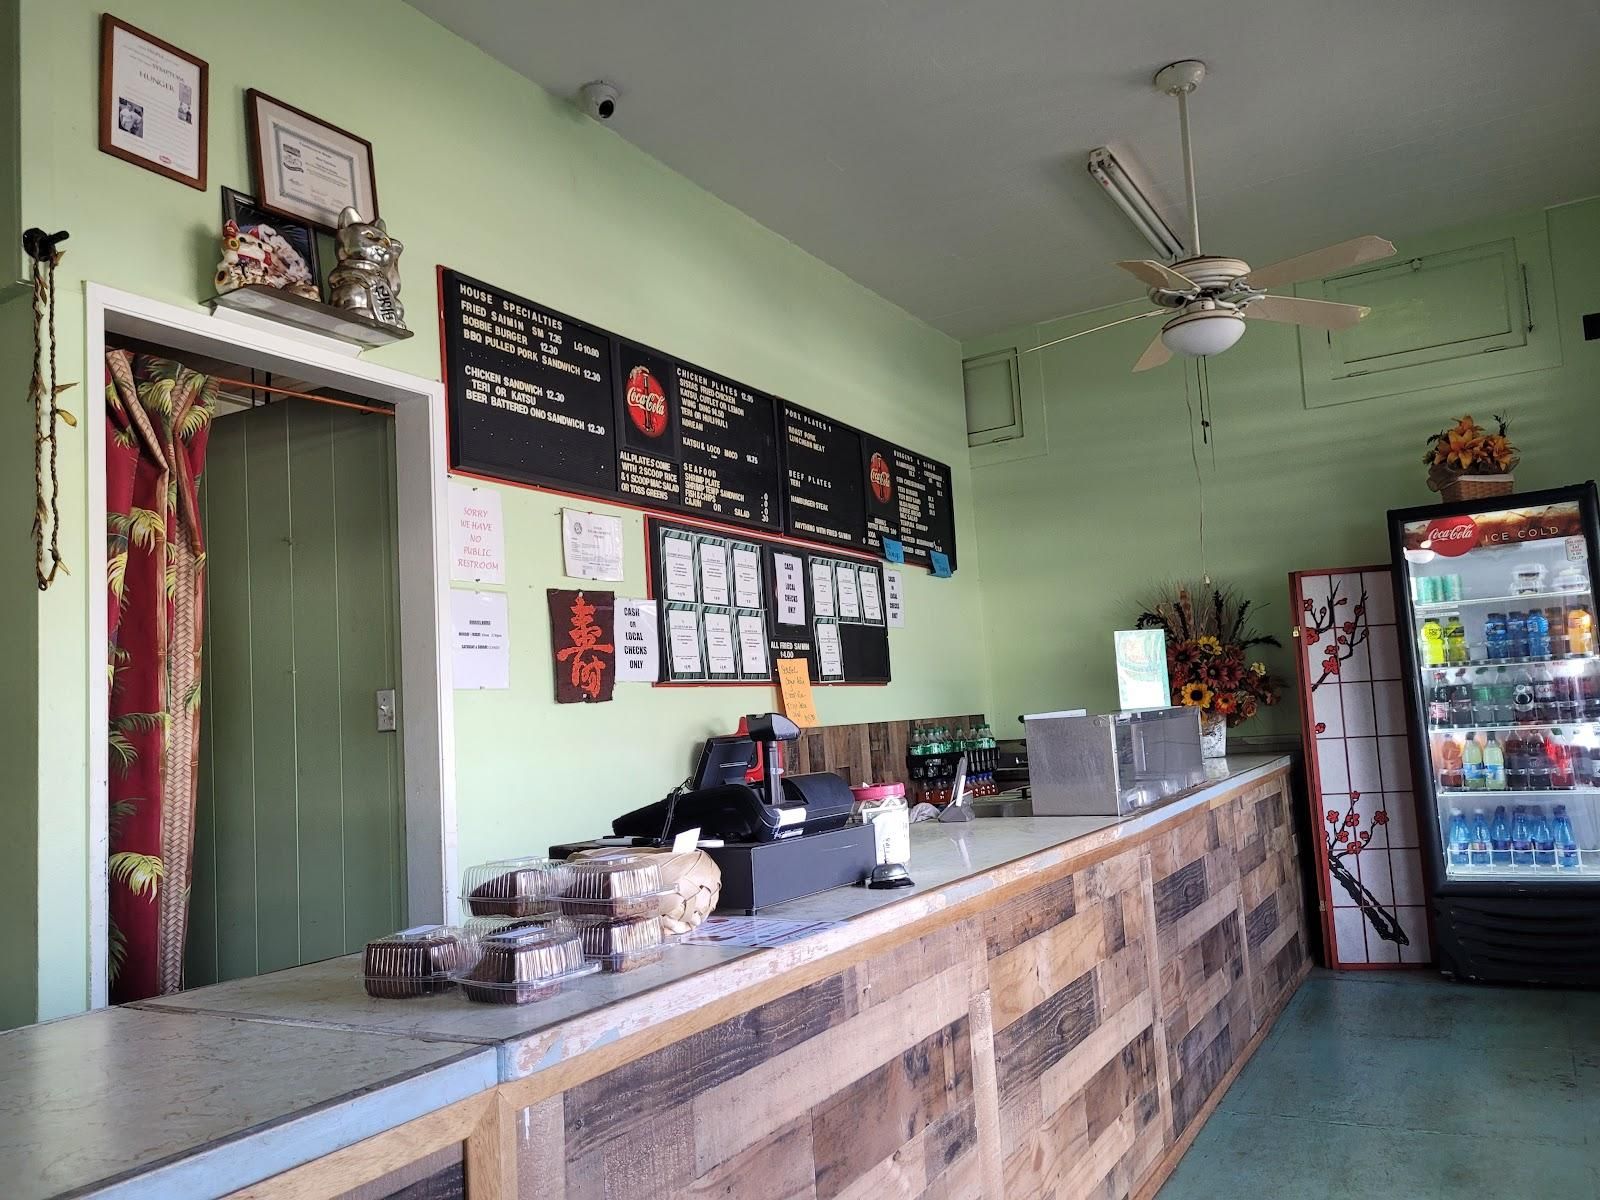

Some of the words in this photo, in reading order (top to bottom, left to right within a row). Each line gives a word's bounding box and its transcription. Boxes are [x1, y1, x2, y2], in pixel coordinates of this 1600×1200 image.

[460, 284, 492, 304] HOUSE
[503, 301, 562, 330] SPECIALTIES
[461, 300, 486, 317] FRIED
[491, 312, 524, 331] SAIMIN
[532, 326, 544, 338] SM
[574, 341, 583, 352] LG
[463, 315, 492, 333] BOBBIE
[495, 325, 528, 345] BURGER
[540, 343, 558, 355] 12.30
[464, 329, 482, 343] BBQ
[485, 336, 515, 354] PULLED
[517, 347, 538, 362] PORK
[542, 355, 580, 375] SANDWICH
[583, 369, 601, 382] 12.30
[465, 365, 501, 384] CHICKEN
[503, 376, 542, 396] SANDWICH
[546, 390, 564, 402] 12.30
[677, 368, 707, 386] CHICKEN
[712, 381, 738, 397] PLATES
[472, 379, 490, 393] TERI
[495, 386, 506, 397] OR
[512, 391, 536, 405] KATSU
[700, 385, 714, 397] FRIED
[715, 391, 736, 405] CHICKEN
[700, 395, 719, 407] CUTLET
[719, 402, 727, 410] OR
[466, 390, 487, 404] BEER
[491, 396, 528, 415] BATTERED
[530, 407, 546, 420] ONO
[547, 412, 584, 430] SANDWICH
[587, 422, 605, 435] 12.30
[681, 406, 693, 417] TERI
[694, 411, 701, 420] OR
[804, 416, 827, 431] PLATES
[683, 437, 700, 449] KATSU
[701, 442, 705, 450] &
[706, 444, 720, 455] LOCO
[813, 442, 825, 453] MEAT
[622, 462, 638, 473] WITH
[639, 466, 643, 474] 2
[644, 467, 663, 479] SCOOP
[664, 472, 677, 483] RICE
[655, 460, 670, 472] COME
[683, 462, 716, 478] SEAFOOD
[621, 472, 626, 481] &
[631, 474, 650, 486] SCOOP
[650, 478, 662, 489] MAC
[663, 481, 679, 493] SALAD
[684, 472, 704, 484] SHRIMP
[705, 478, 720, 488] PLATE
[684, 481, 705, 493] SHRIMP
[789, 470, 804, 481] BEEF
[808, 476, 832, 489] PLATES
[790, 479, 801, 488] TERI
[621, 482, 629, 492] OR
[630, 484, 645, 496] TOSS
[646, 488, 668, 500] GREENS
[464, 506, 488, 518] SORRY
[713, 503, 721, 512] OR
[460, 519, 470, 528] WE
[472, 521, 492, 531] HAVE
[1428, 523, 1475, 542] Coca-Cola
[470, 534, 481, 543] NO
[1485, 532, 1509, 542] ICE
[1517, 526, 1559, 540] COLD
[464, 546, 492, 556] PUBLIC
[458, 558, 498, 570] RESTROOM
[784, 562, 794, 571] CASH
[786, 583, 795, 591] LOCAL
[785, 594, 798, 602] CHECKS
[624, 607, 640, 617] CASH
[625, 632, 643, 641] LOCAL
[624, 646, 648, 655] CHECKS
[779, 641, 793, 650] FRIED
[629, 660, 644, 669] ONLY
